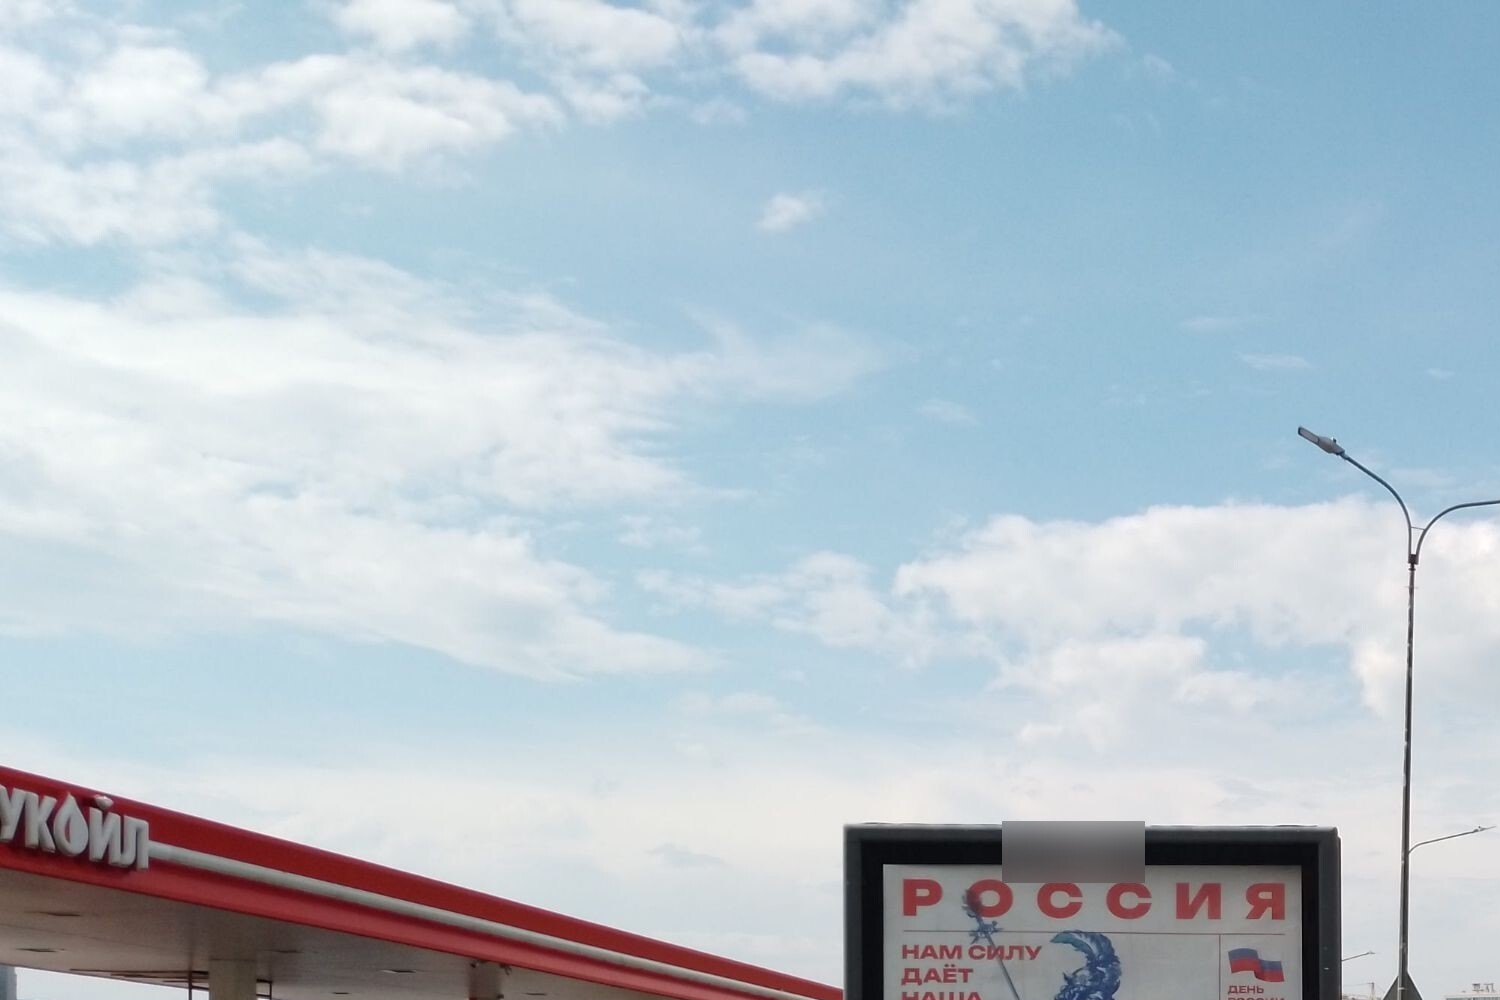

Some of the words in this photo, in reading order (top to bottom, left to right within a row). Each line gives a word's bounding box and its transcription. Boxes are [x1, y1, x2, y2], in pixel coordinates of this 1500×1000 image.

[902, 878, 1286, 920] РОССИЯ
[901, 944, 962, 960] НАМ
[968, 944, 1042, 961] СИЛУ
[901, 963, 974, 986] ДАЁТ
[1227, 985, 1265, 995] ДЕНЬ
